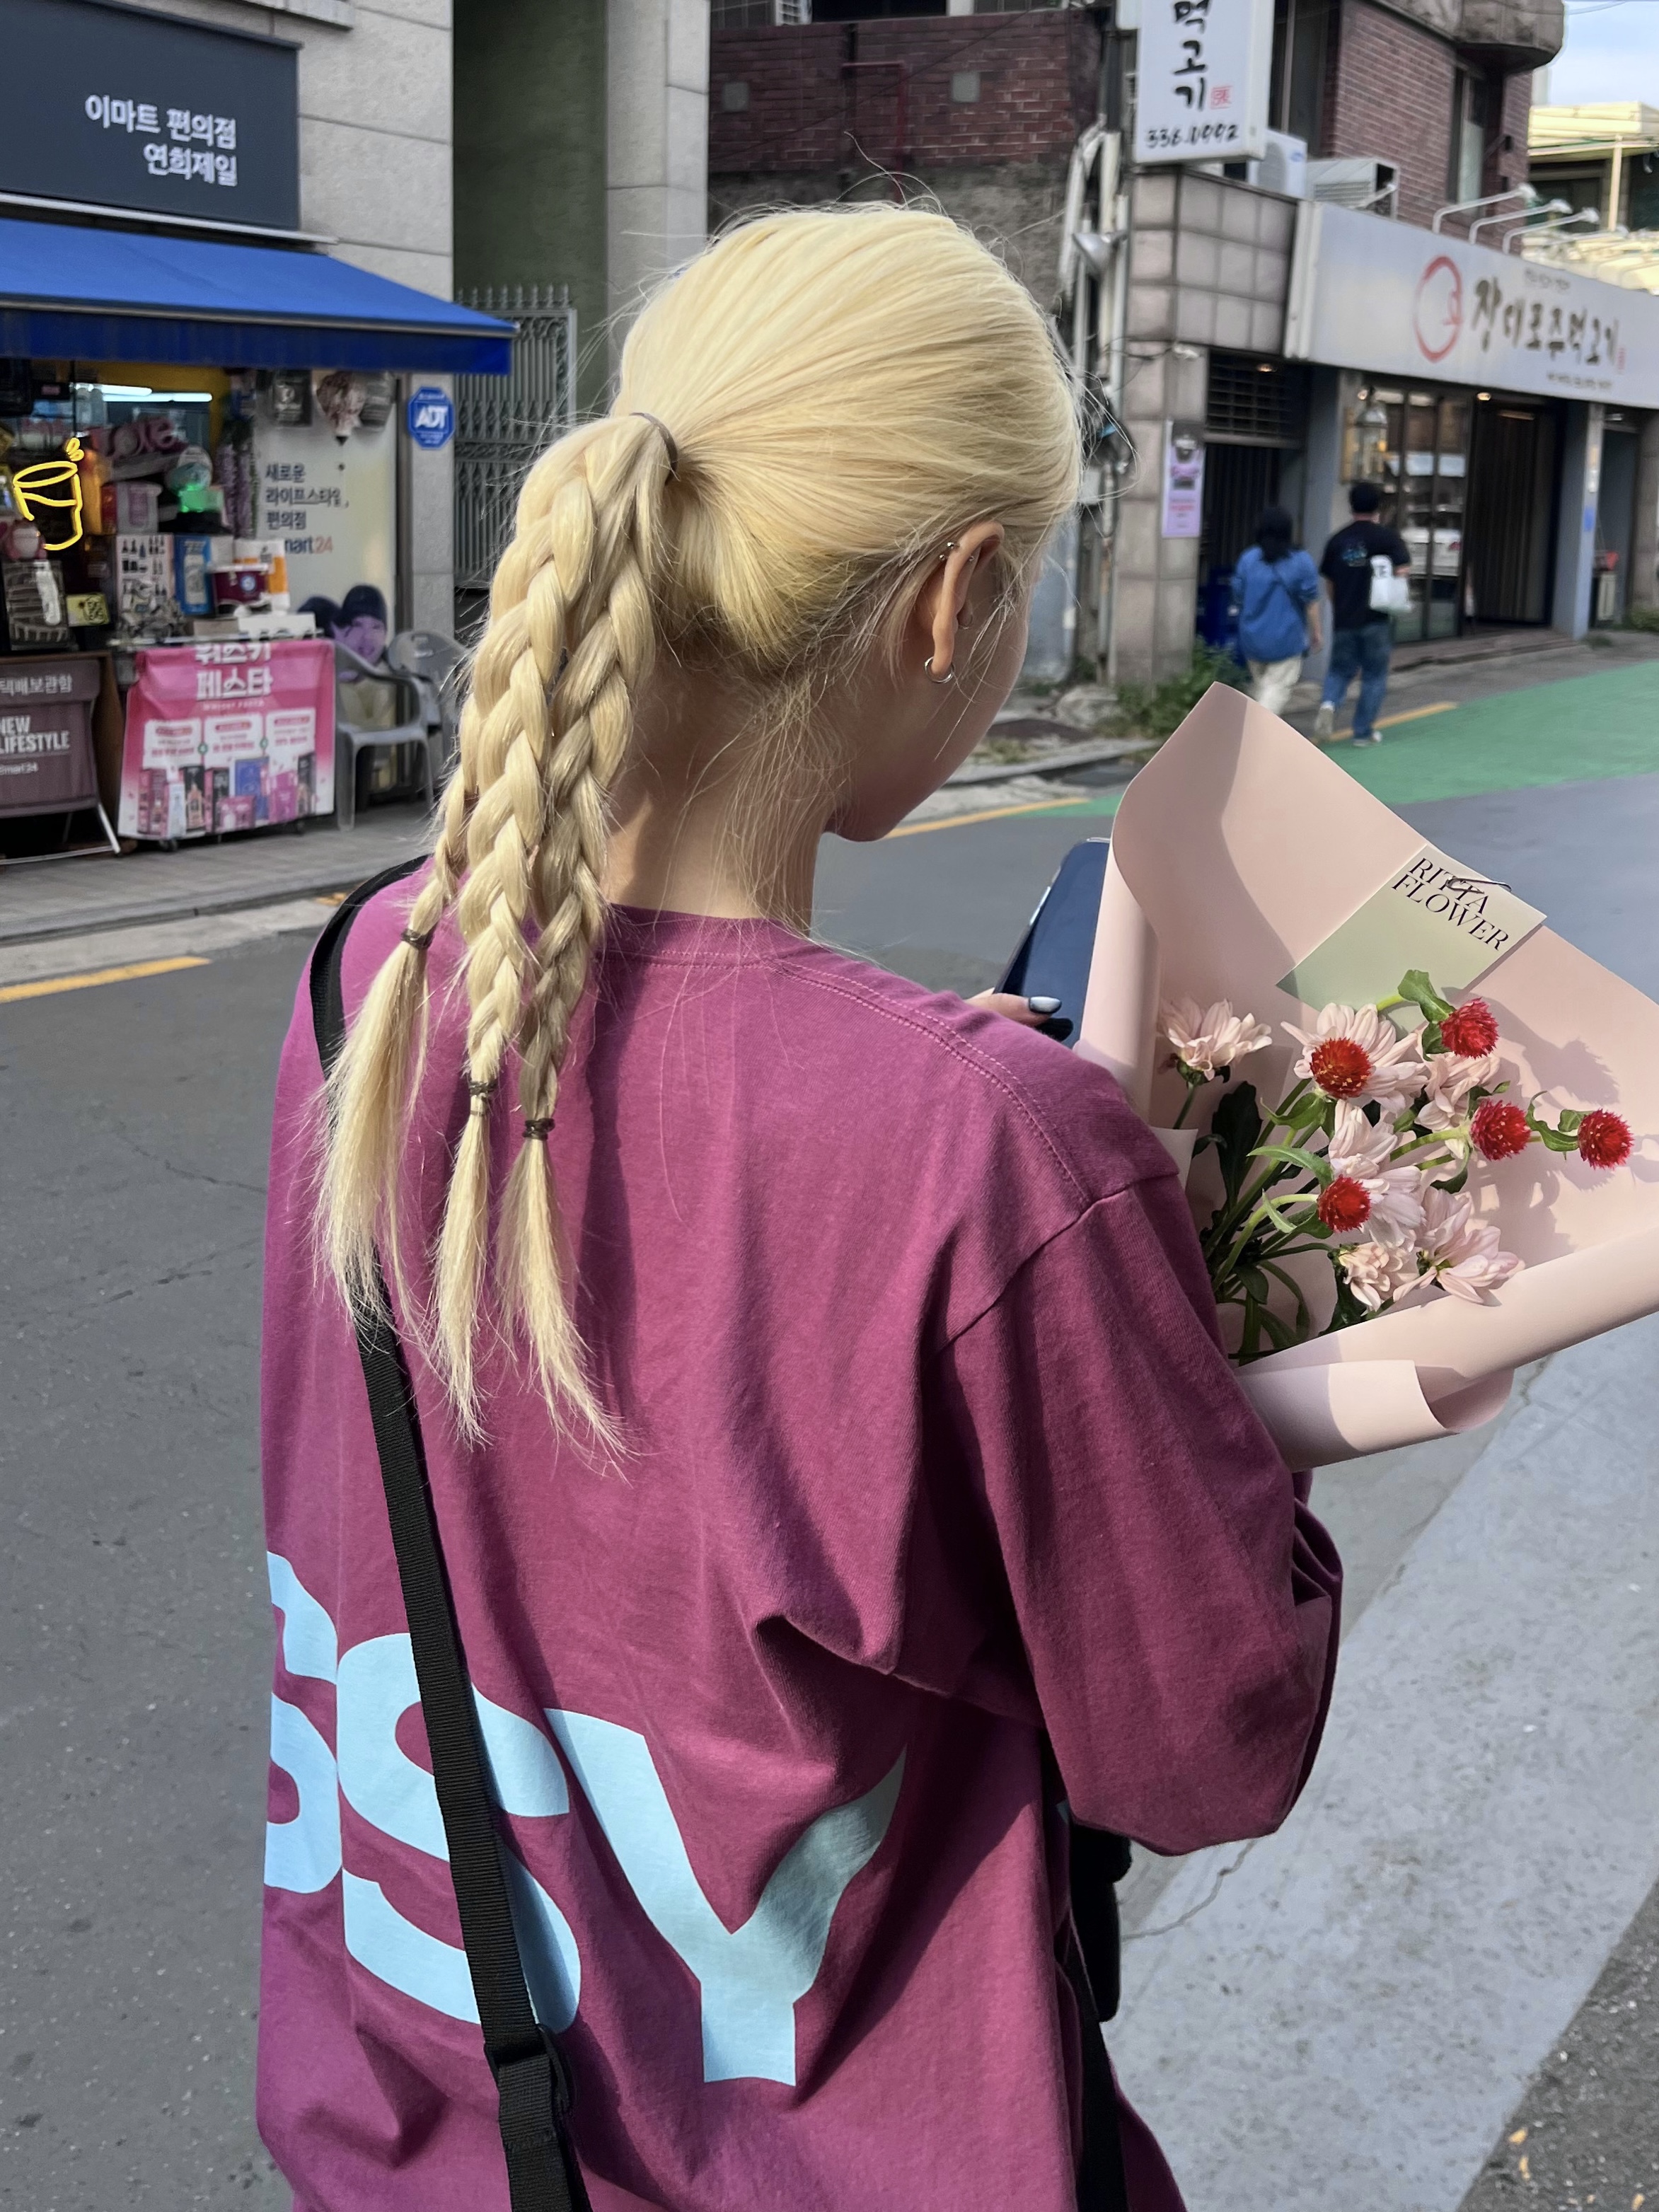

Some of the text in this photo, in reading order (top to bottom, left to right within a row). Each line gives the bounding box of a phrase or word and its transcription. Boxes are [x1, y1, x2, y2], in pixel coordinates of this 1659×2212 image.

[85, 95, 236, 151] 이마트 편의점
[143, 143, 238, 187] 연희제일
[415, 404, 449, 429] ADT
[265, 462, 306, 483] 새로운
[267, 509, 307, 530] 편의점
[197, 666, 274, 700] 페스타
[1409, 857, 1489, 915] RITTA
[1391, 873, 1509, 951] FLOWER
